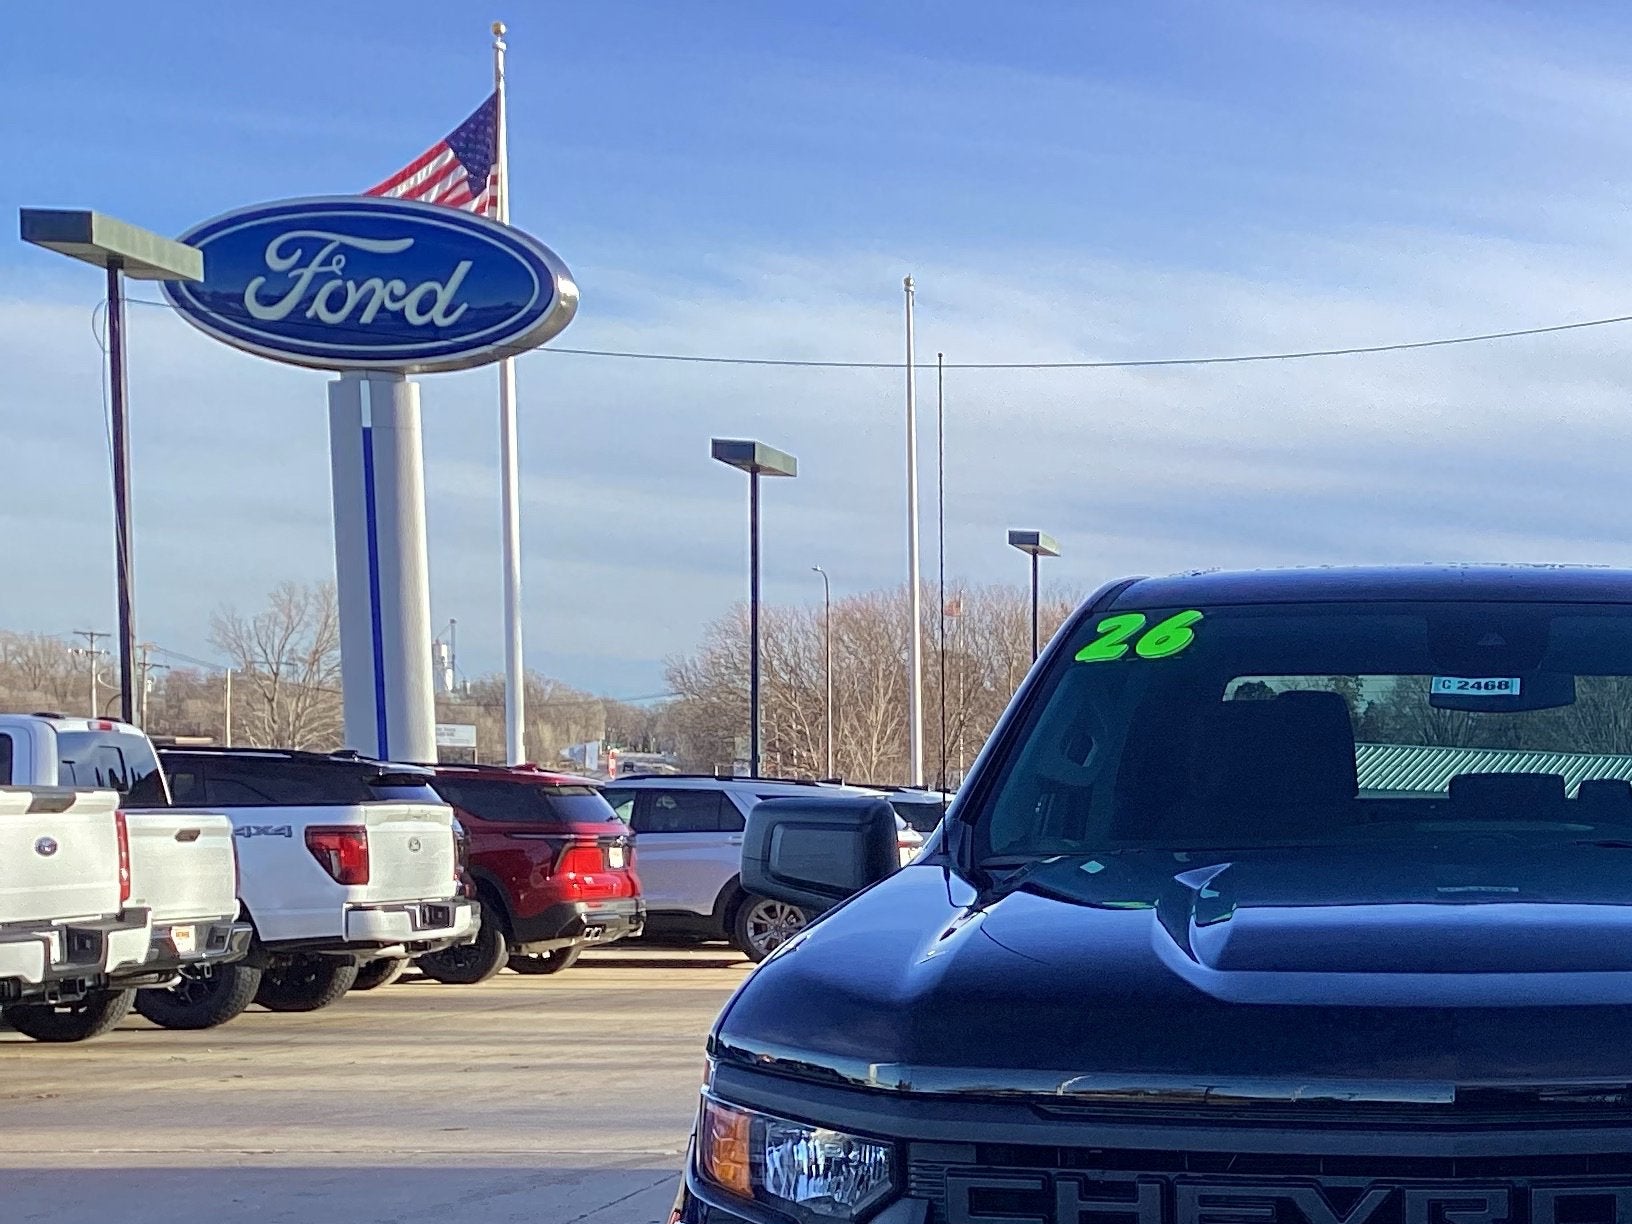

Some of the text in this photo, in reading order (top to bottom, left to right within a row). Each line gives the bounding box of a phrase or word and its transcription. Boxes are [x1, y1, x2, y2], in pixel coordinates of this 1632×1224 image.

[244, 230, 474, 327] Ford
[1075, 610, 1204, 662] 26
[1457, 680, 1510, 691] 2468
